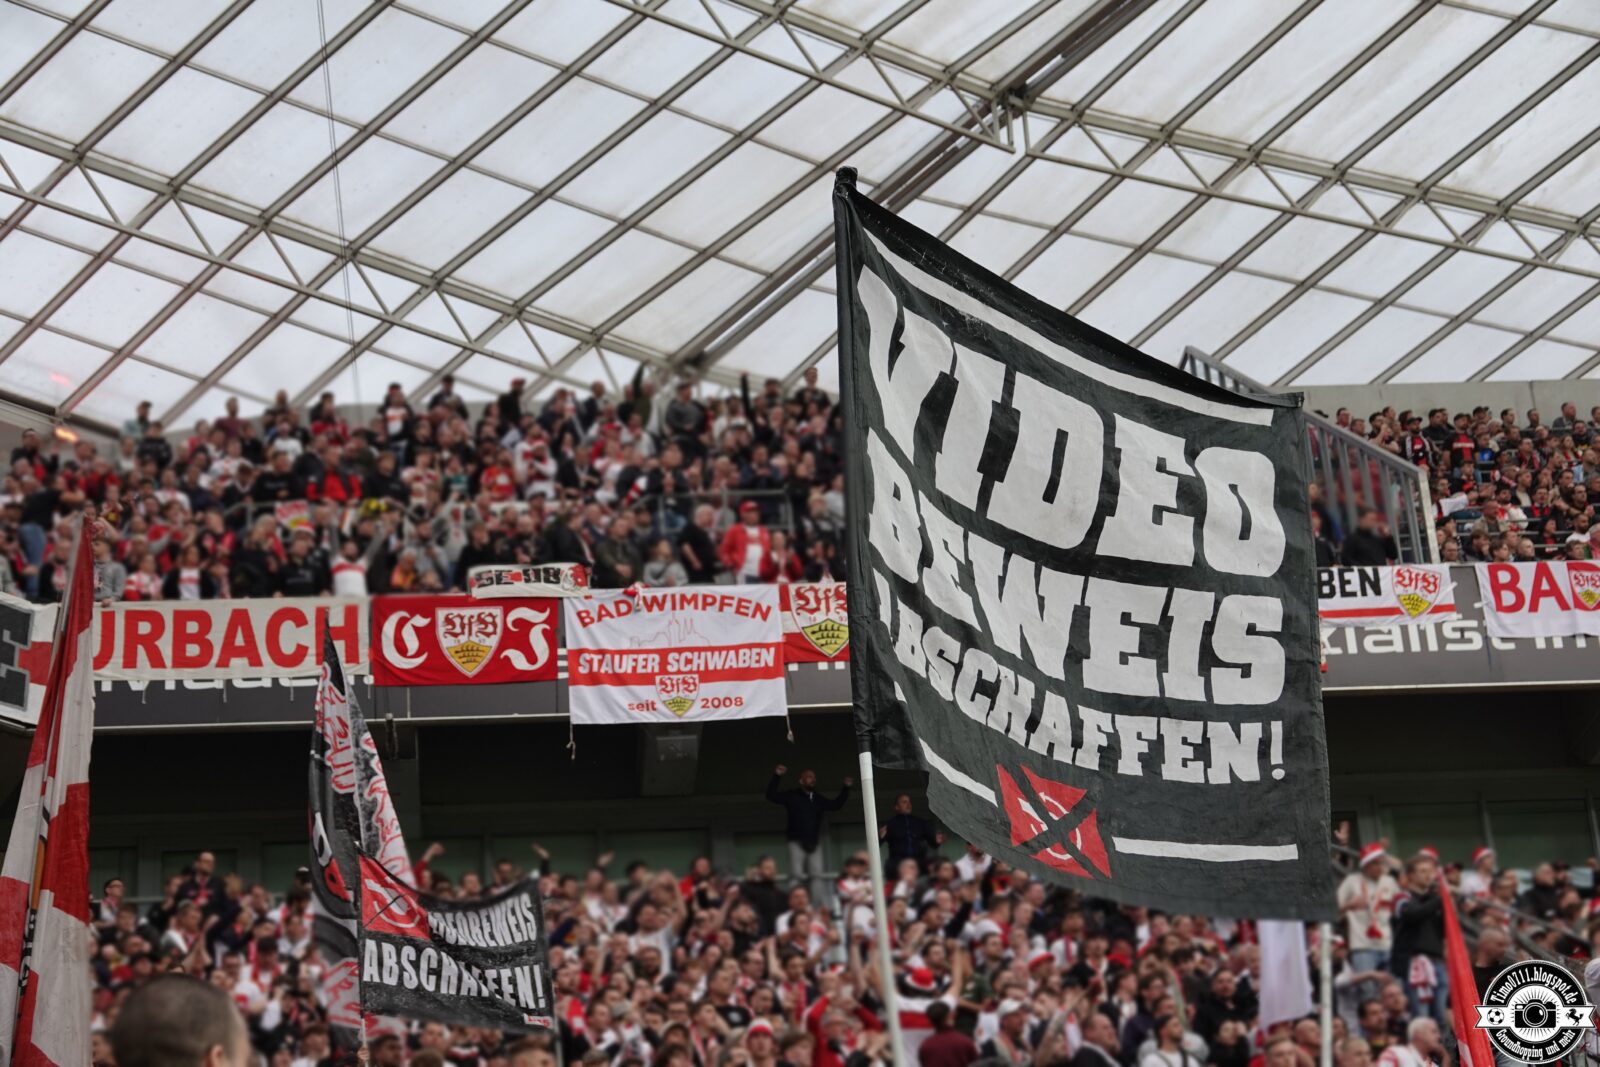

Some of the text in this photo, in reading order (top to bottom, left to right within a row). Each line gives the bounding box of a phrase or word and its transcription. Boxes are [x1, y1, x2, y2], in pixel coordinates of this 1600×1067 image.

[858, 264, 1286, 577] VIDEO
[868, 427, 1286, 705] BEWEIS
[576, 593, 772, 628] BAD WIMPFEN
[578, 652, 660, 674] STAUFER
[667, 647, 775, 673] SCHWABEN
[628, 696, 744, 712] seit 2008
